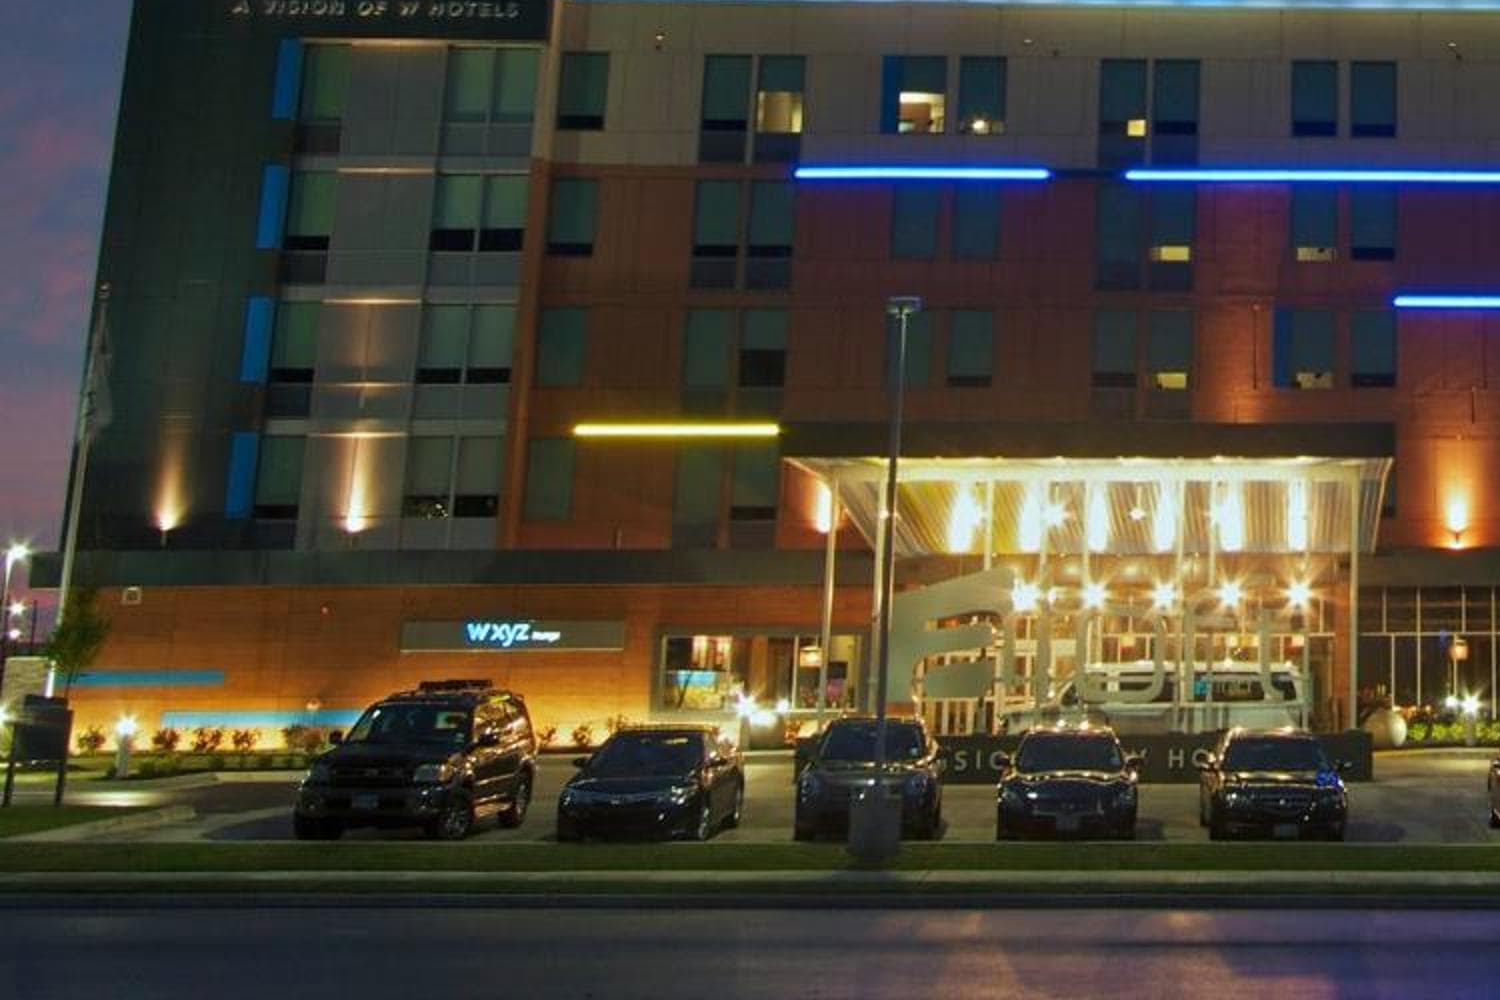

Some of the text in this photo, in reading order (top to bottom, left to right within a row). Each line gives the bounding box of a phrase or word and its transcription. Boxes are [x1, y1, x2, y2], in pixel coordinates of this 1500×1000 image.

[232, 0, 249, 15] A
[263, 0, 345, 15] VISION
[358, 1, 387, 17] OF
[428, 1, 519, 18] HOTELS
[467, 623, 530, 647] wxyz
[882, 567, 1298, 706] aloft
